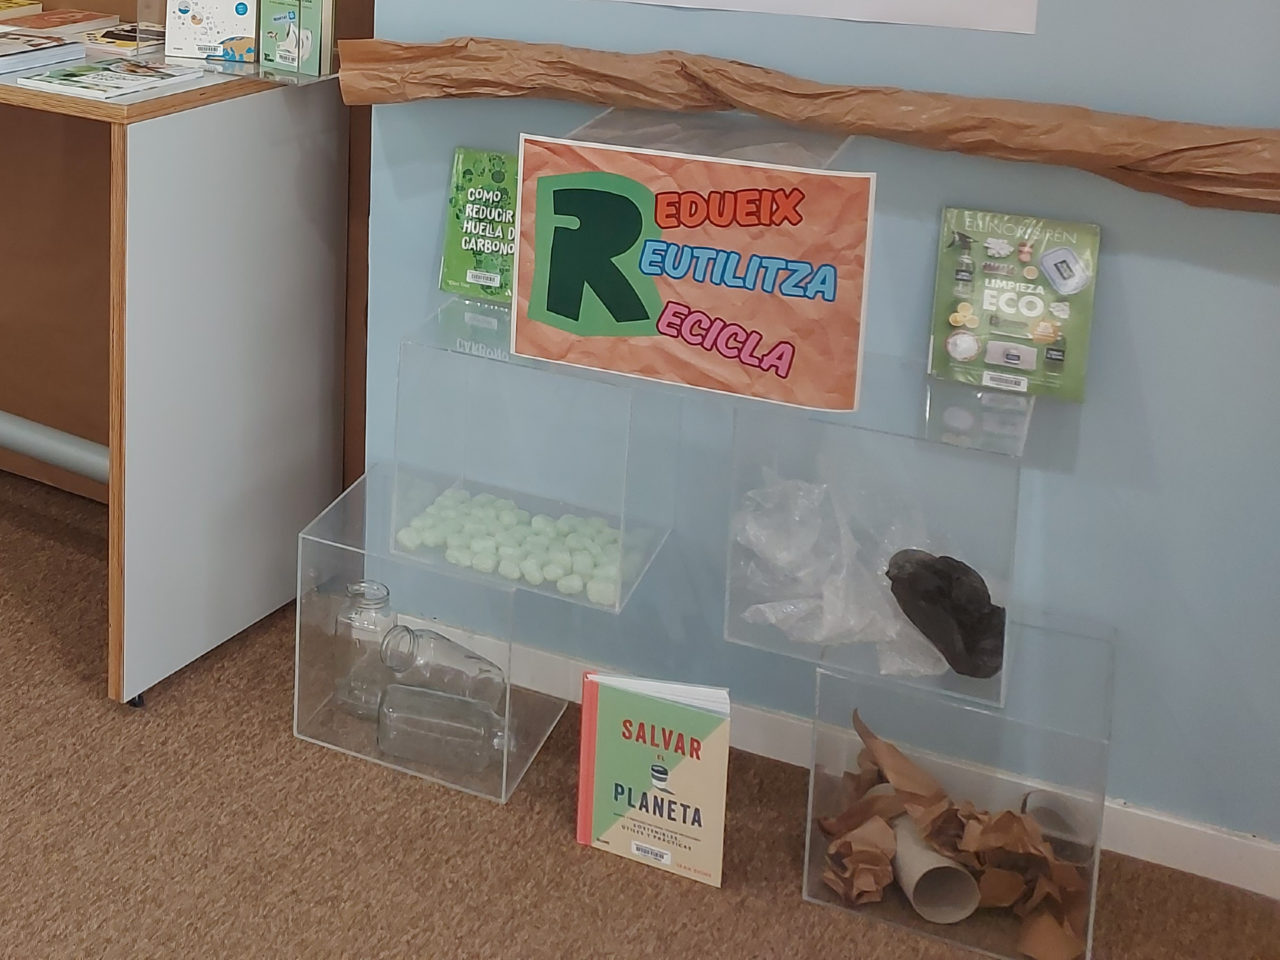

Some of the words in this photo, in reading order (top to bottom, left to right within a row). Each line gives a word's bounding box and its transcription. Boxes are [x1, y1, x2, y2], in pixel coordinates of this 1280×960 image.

[468, 185, 501, 203] CÓMO
[465, 204, 514, 223] REDUCIR
[653, 188, 805, 229] EDUEIX
[463, 220, 503, 238] HUELLA
[462, 237, 515, 254] CARBONO
[639, 239, 838, 302] EUTILITZA
[985, 278, 1044, 295] LIMPIEZA
[983, 289, 1044, 317] ECO
[656, 301, 796, 379] ECICLA
[622, 719, 702, 761] SALVAR
[614, 783, 703, 828] PLANETA
